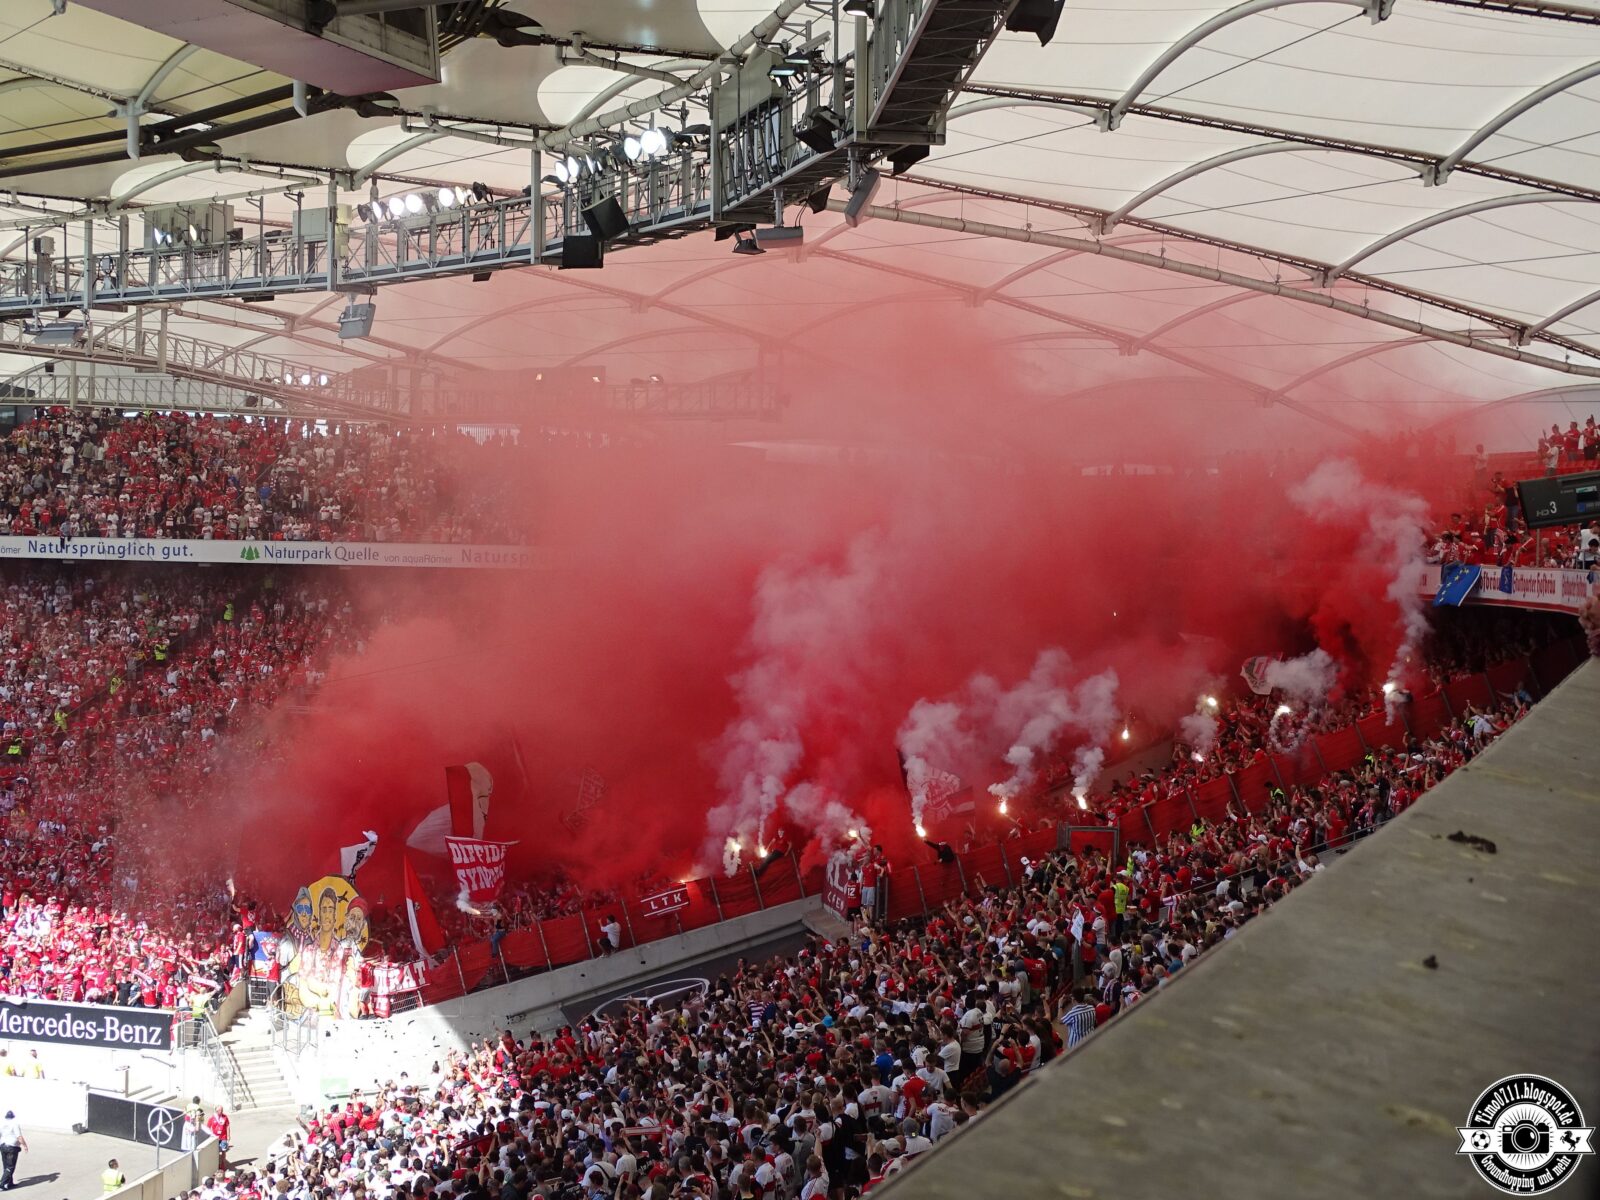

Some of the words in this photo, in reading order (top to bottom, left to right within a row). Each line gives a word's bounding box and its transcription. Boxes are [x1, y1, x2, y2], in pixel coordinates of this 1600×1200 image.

[1549, 500, 1558, 514] 3
[162, 544, 194, 559] gut.
[264, 544, 332, 562] Naturpark
[334, 546, 379, 561] Quelle
[384, 554, 400, 564] von
